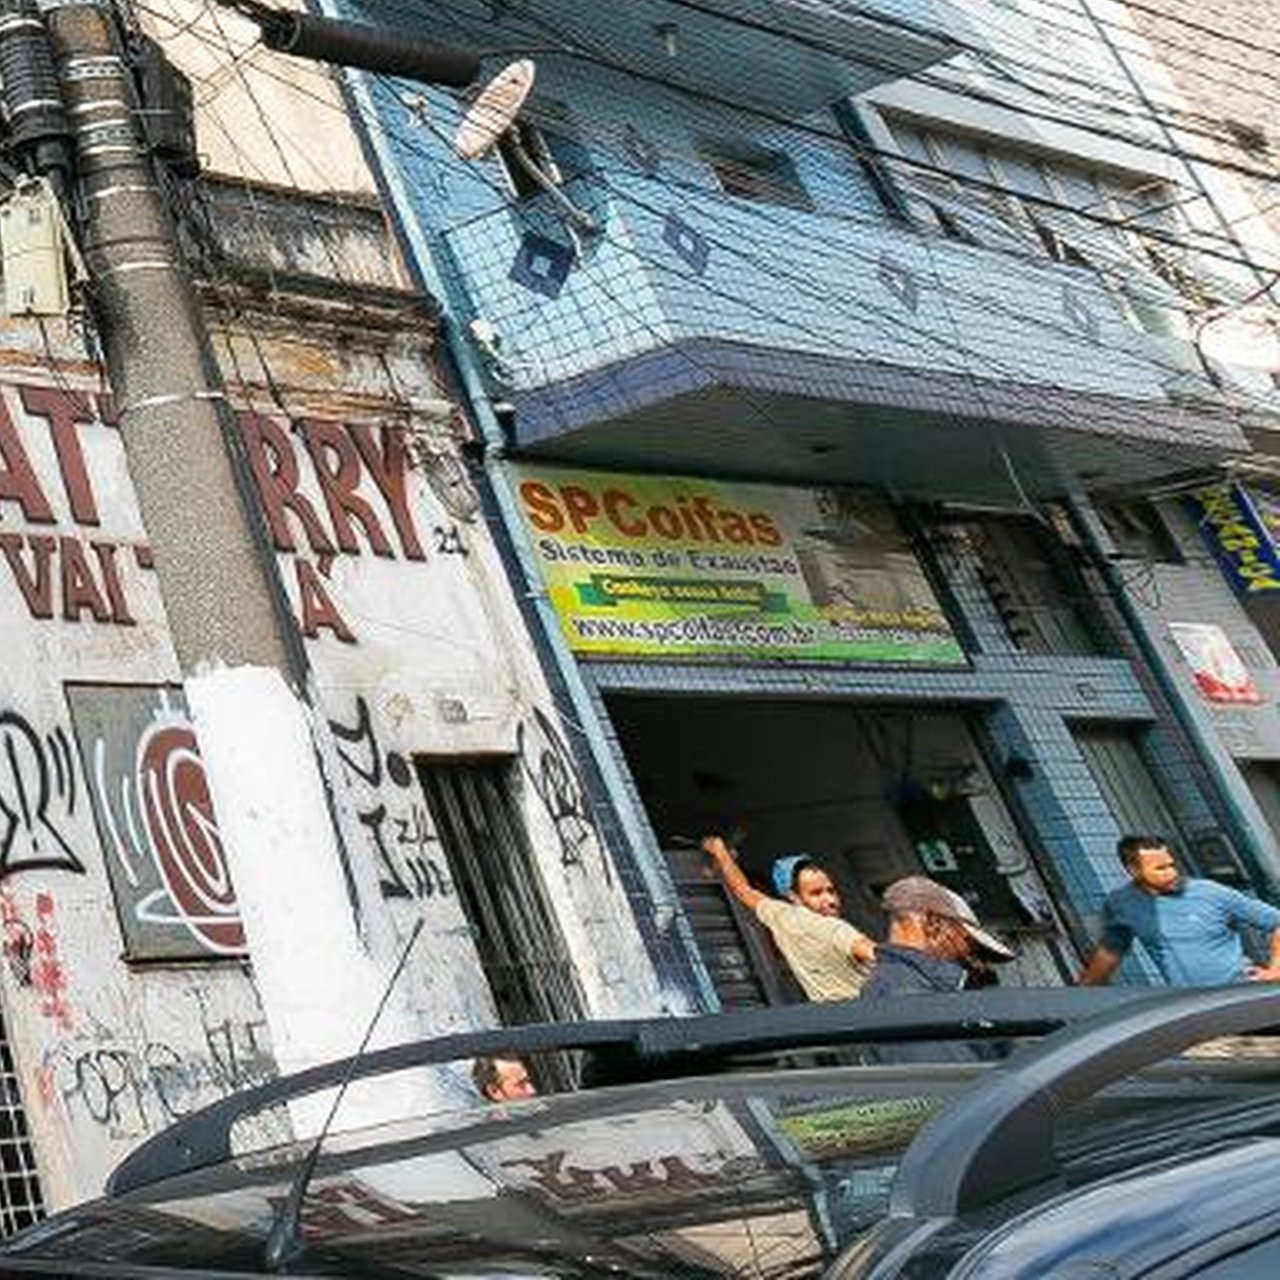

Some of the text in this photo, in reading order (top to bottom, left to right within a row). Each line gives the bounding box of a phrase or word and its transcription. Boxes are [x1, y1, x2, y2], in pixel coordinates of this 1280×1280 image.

[519, 480, 784, 547] SPCoifas
[539, 540, 644, 568] Sistema
[651, 548, 681, 567] de
